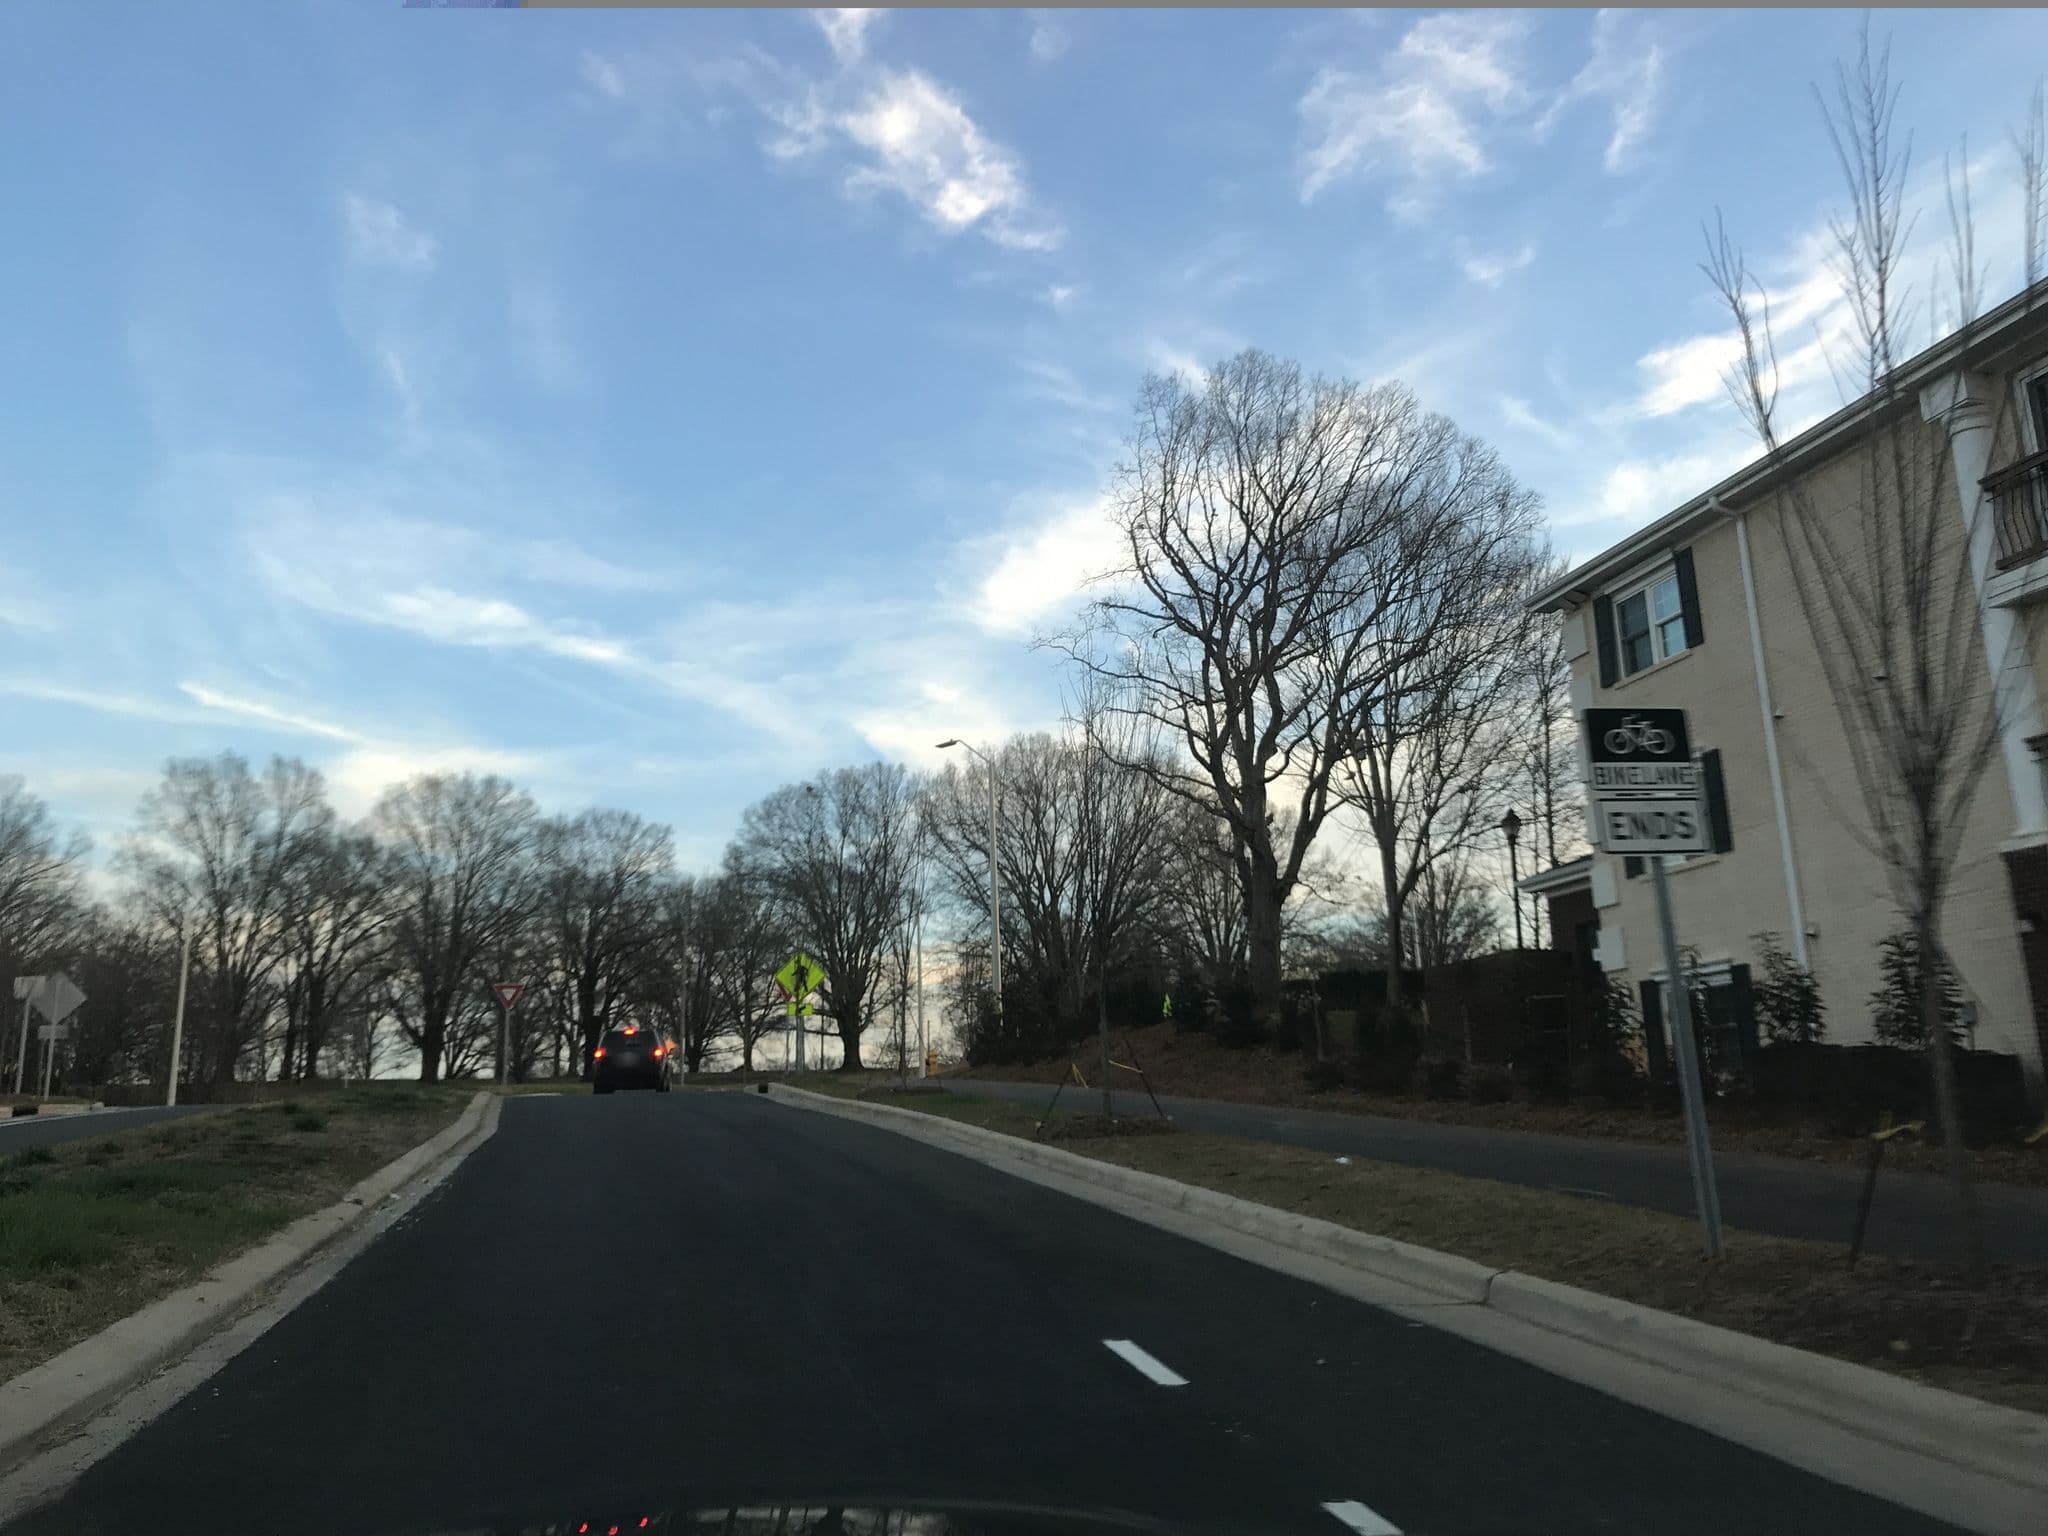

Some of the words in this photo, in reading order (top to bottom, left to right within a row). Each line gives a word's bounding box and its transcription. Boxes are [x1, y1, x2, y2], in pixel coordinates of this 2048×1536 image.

[1594, 767, 1640, 785] BIKE
[1642, 767, 1696, 785] LANE
[1608, 811, 1697, 840] ENDS
